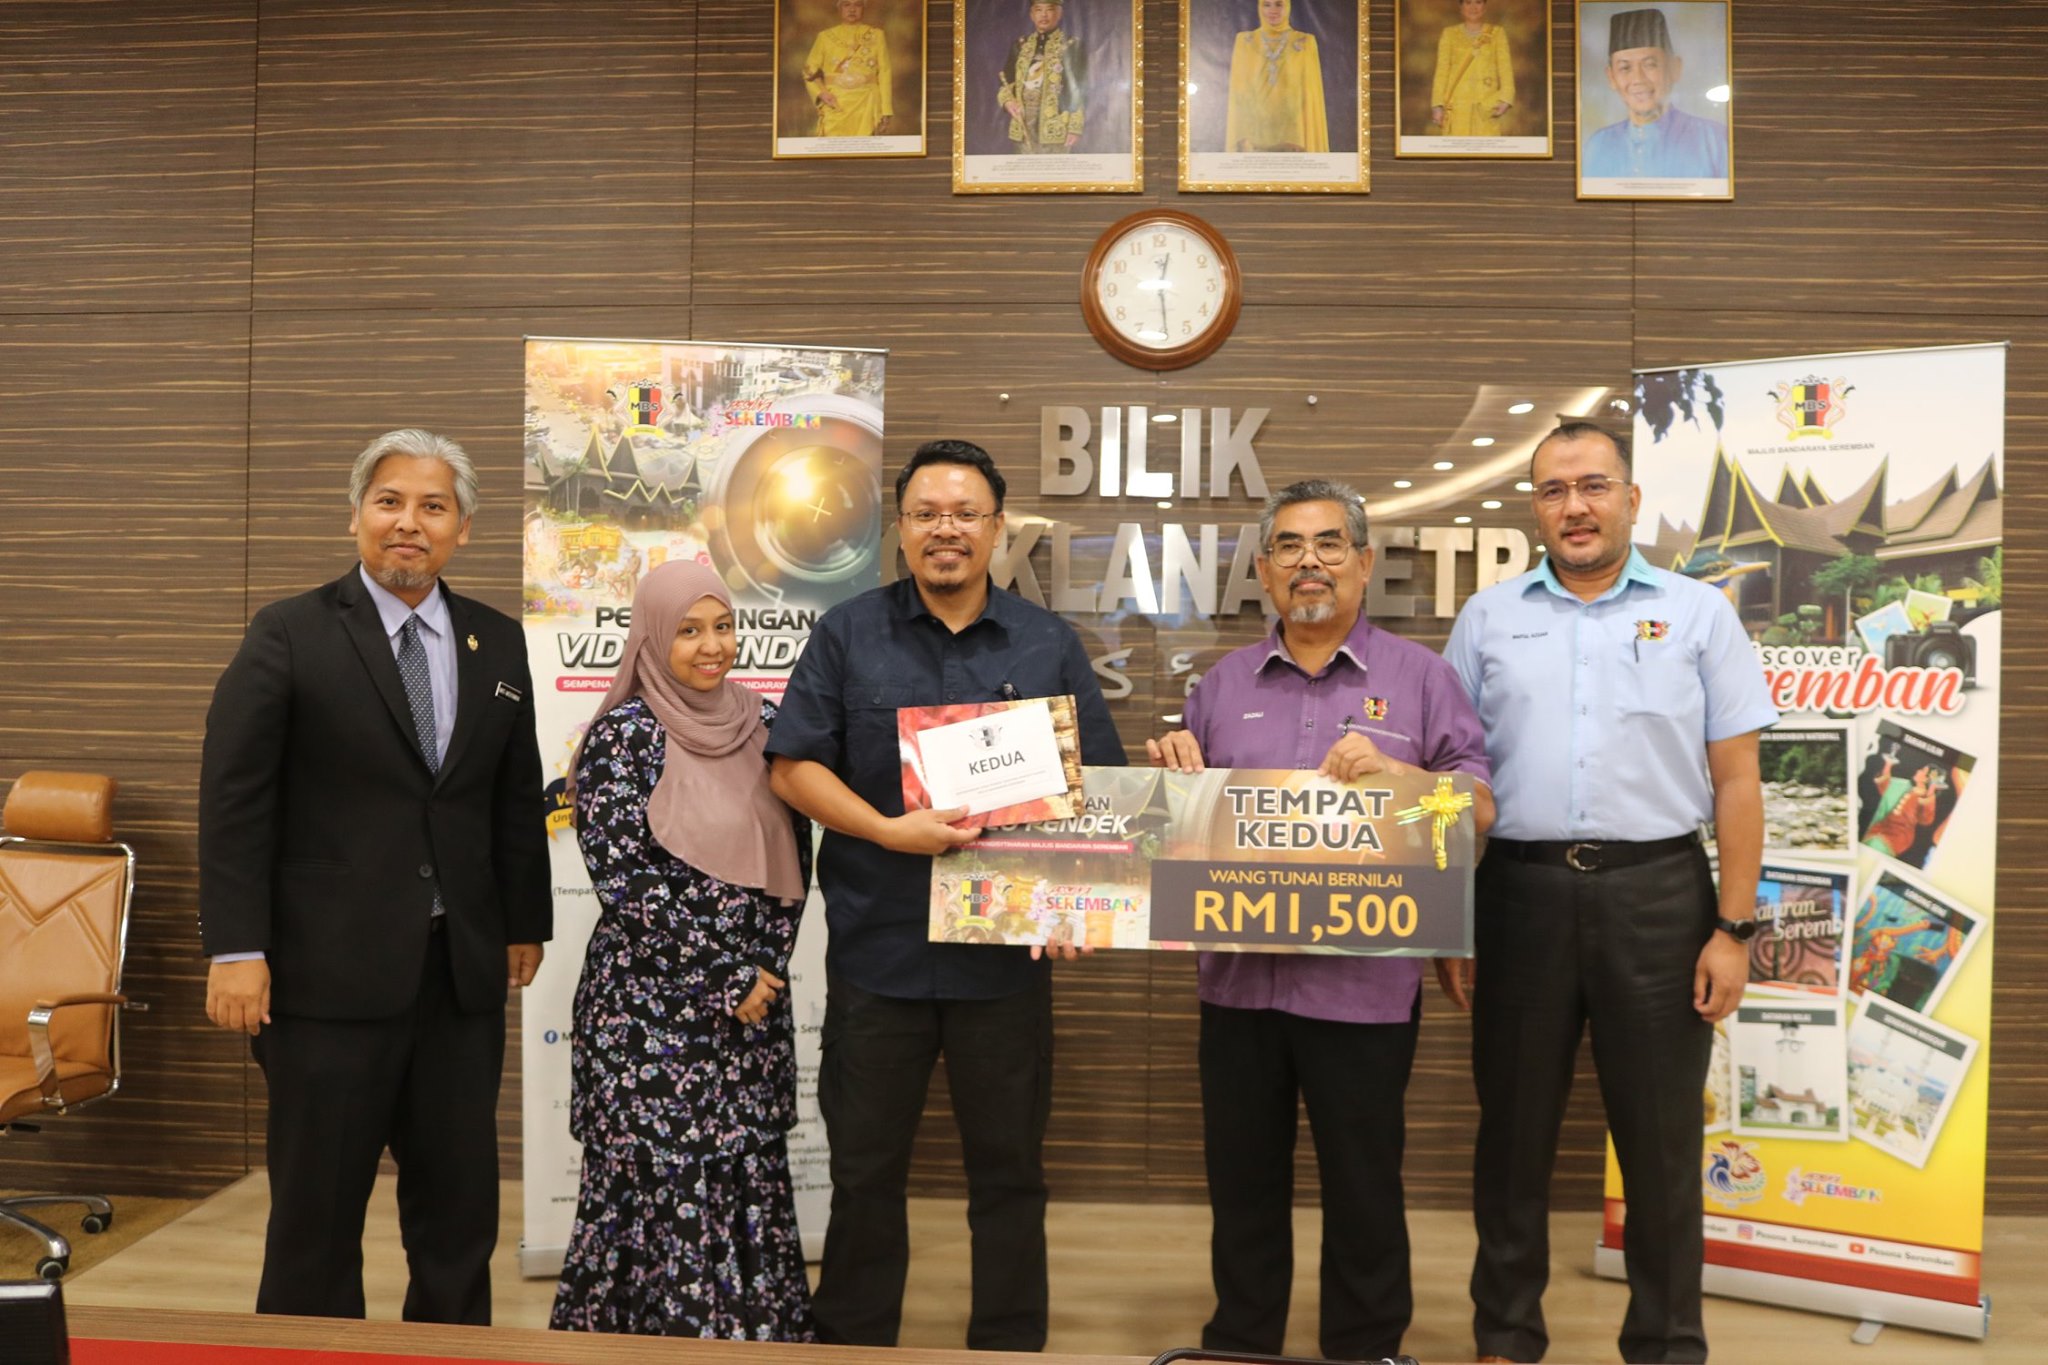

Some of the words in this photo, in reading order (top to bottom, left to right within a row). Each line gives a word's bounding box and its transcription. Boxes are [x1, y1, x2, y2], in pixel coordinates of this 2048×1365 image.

[1152, 234, 1167, 247] 12
[1130, 242, 1142, 255] 11
[1114, 260, 1127, 273] 10
[1197, 255, 1207, 268] 2
[1107, 283, 1117, 297] 9
[1207, 278, 1216, 292] 3
[1116, 306, 1126, 320] 8
[1198, 302, 1208, 316] 4
[1182, 321, 1191, 334] 5
[630, 402, 658, 411] MBS
[1795, 400, 1826, 411] MBS
[1040, 406, 1271, 498] BILIK
[558, 633, 626, 668] VID
[1762, 650, 1859, 666] scover
[563, 680, 612, 688] SEMPENA
[968, 750, 1026, 776] KEDUA
[1227, 787, 1392, 817] TEMPAT
[1237, 821, 1382, 850] KEDUA
[1209, 869, 1266, 884] WANG
[1268, 870, 1324, 886] TUNAI
[1327, 872, 1403, 888] BERNILAI
[963, 894, 989, 903] MBS
[1046, 896, 1139, 912] SEREMBAN
[1193, 889, 1419, 943] RM1,500
